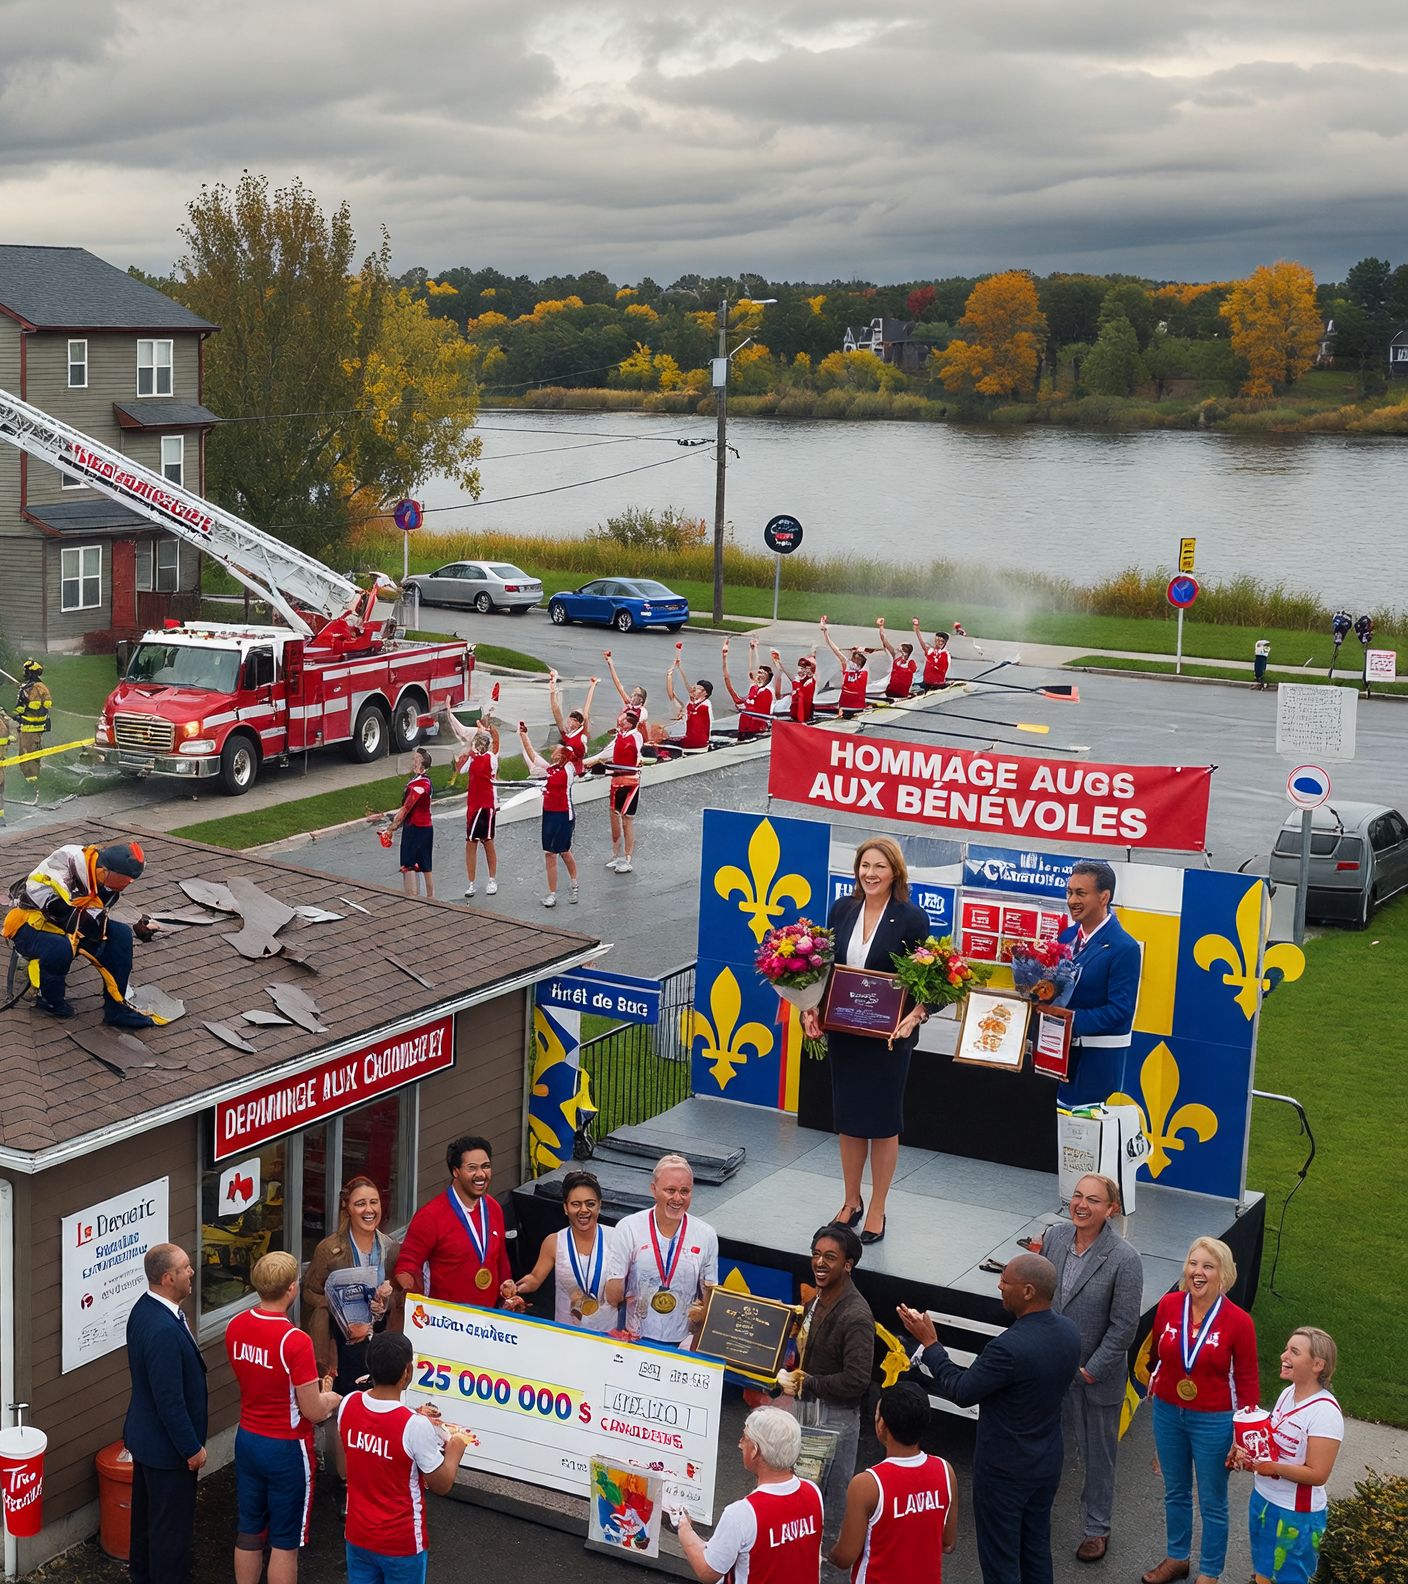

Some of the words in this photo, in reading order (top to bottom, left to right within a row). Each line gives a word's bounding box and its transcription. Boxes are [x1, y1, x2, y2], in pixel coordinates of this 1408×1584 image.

[830, 740, 1019, 790] HOMMAGE
[1029, 765, 1135, 799] AUGS
[808, 772, 886, 811] AUX
[896, 780, 1148, 839] BÉNÉVOLES
[592, 993, 613, 1009] de
[323, 1061, 359, 1102] AUX
[233, 1340, 274, 1370] LAVAL
[416, 1360, 452, 1392] 25
[458, 1370, 511, 1405] 000
[518, 1384, 573, 1421] 000
[578, 1402, 592, 1424] $
[347, 1429, 393, 1460] LAVAL
[893, 1489, 945, 1519] LAVAL
